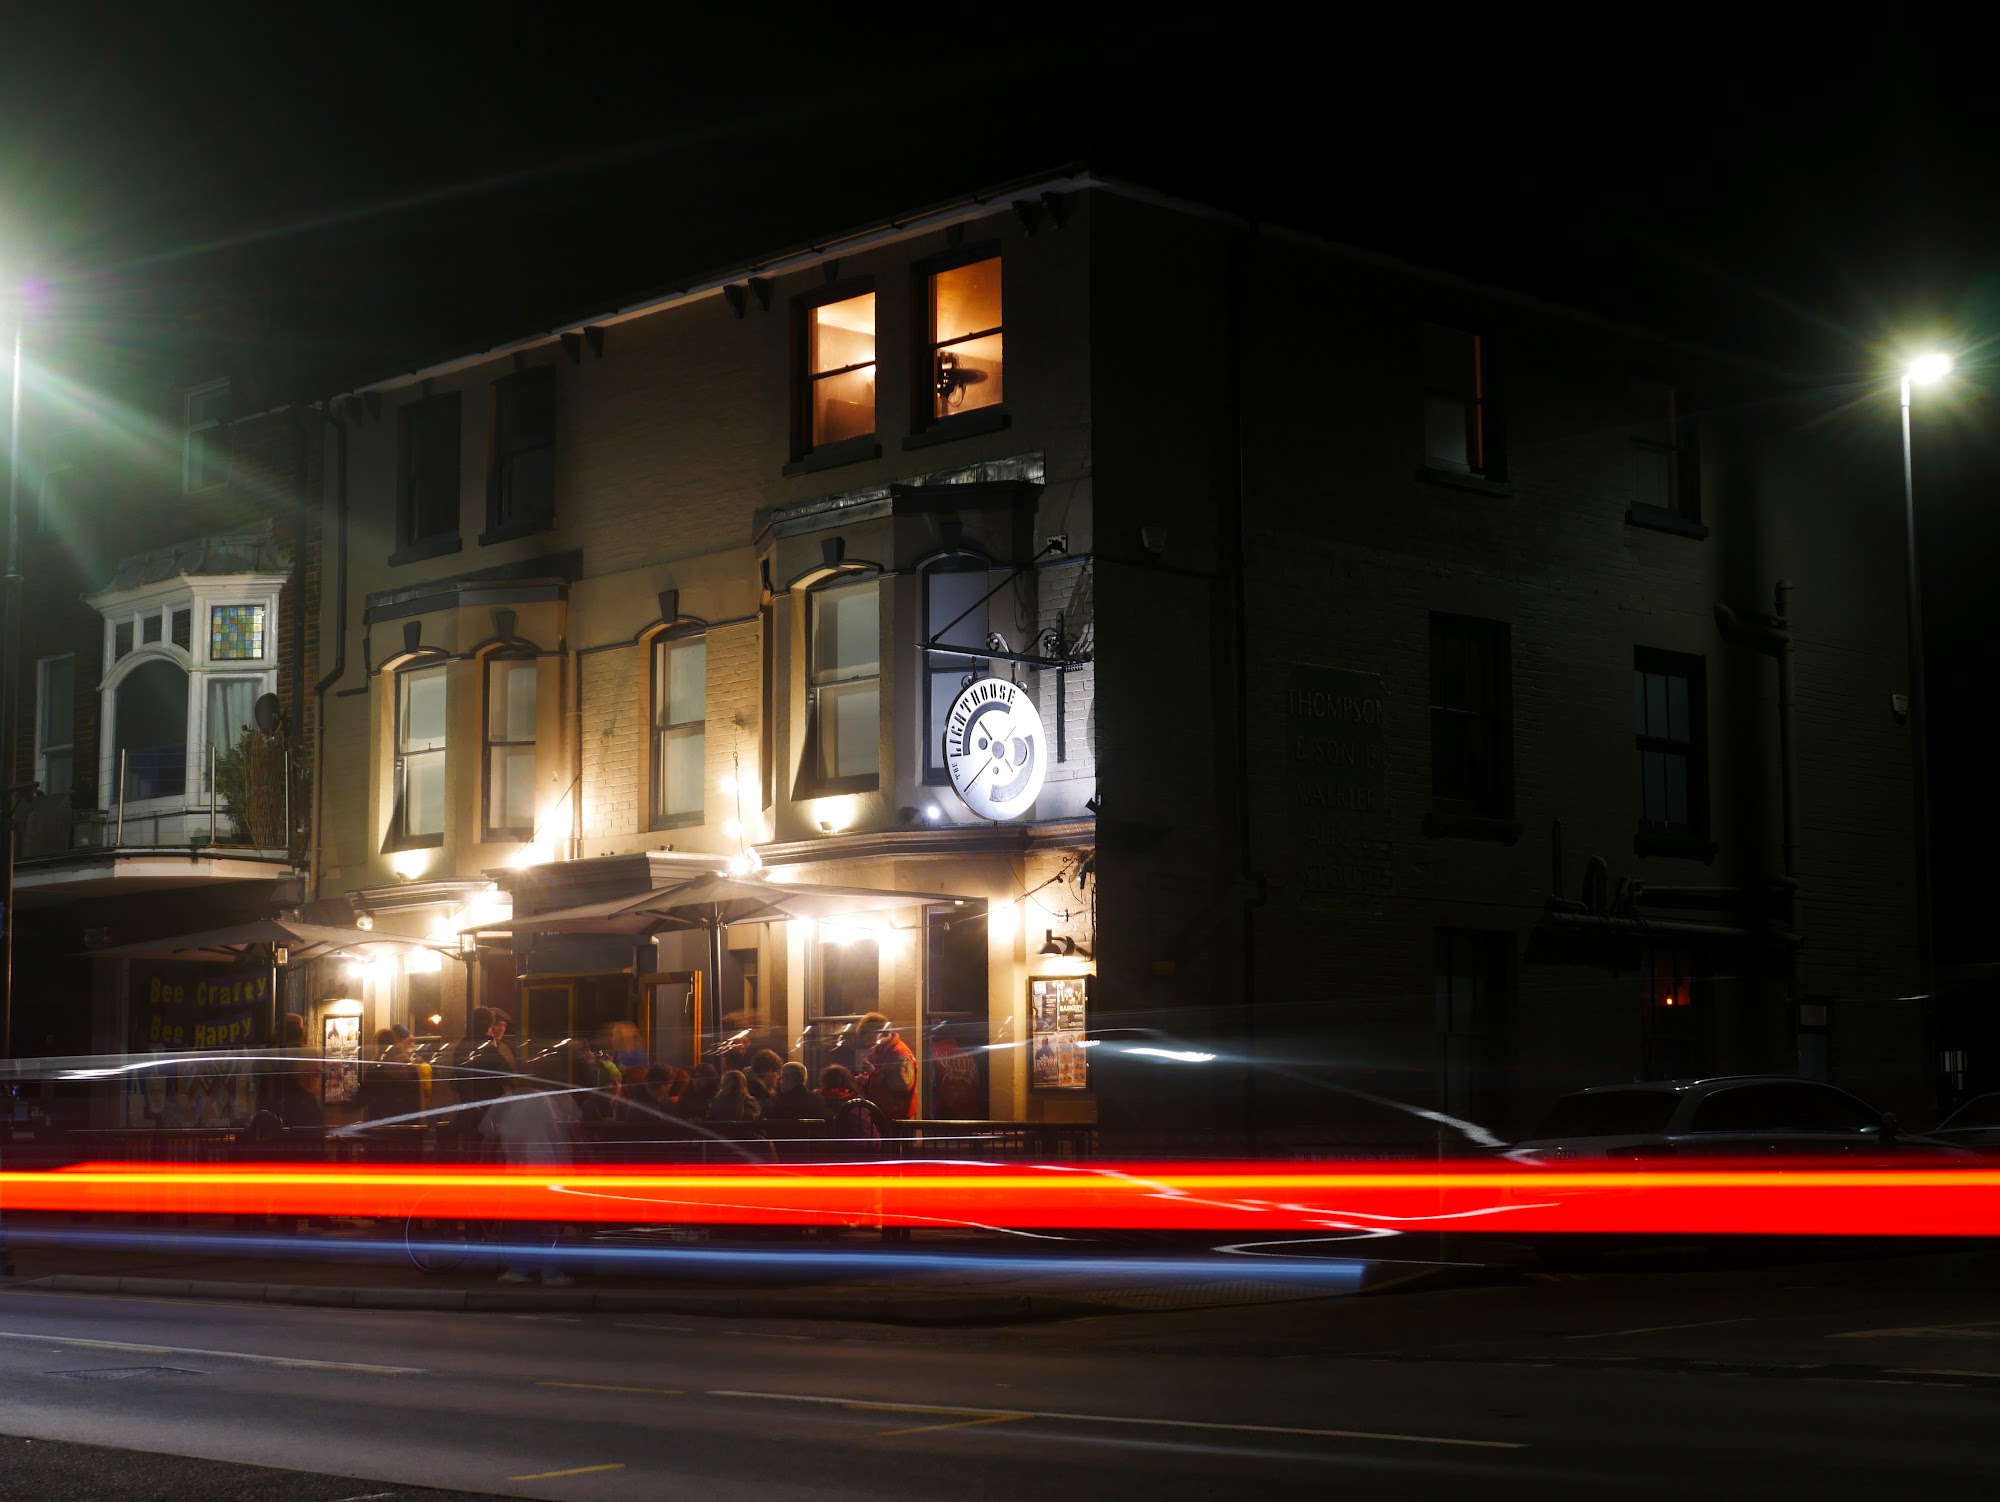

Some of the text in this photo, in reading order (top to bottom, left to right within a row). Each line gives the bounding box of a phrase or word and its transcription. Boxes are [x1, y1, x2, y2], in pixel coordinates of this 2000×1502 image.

[949, 683, 1017, 758] LIGHTHOUSE
[1287, 688, 1384, 725] THOMPSON
[951, 762, 960, 782] THE
[149, 976, 268, 1007] Bee Crafty
[149, 1015, 253, 1049] Bee Happy
